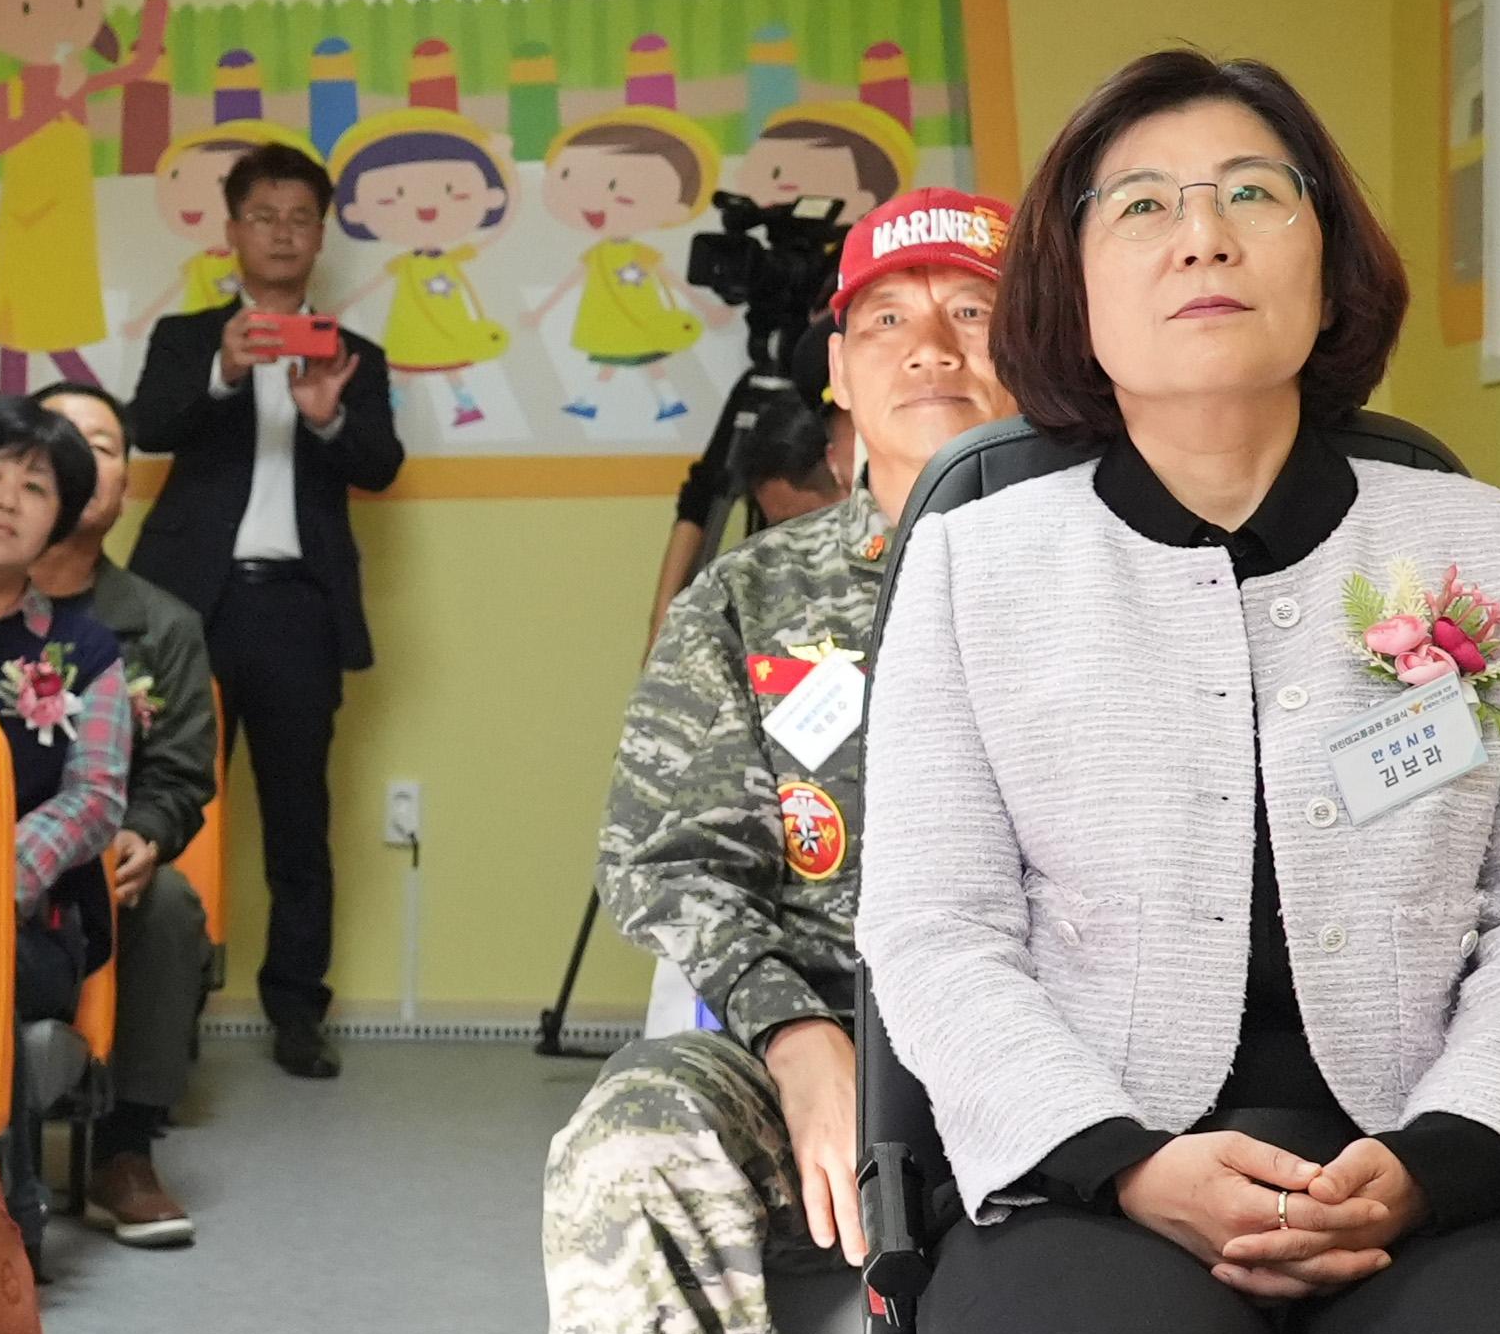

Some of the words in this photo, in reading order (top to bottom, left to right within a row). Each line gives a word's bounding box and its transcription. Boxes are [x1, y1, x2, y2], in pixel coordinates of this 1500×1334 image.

[872, 208, 991, 259] MARINES
[1371, 723, 1437, 765] 안성시장
[1379, 744, 1443, 788] 김보라
